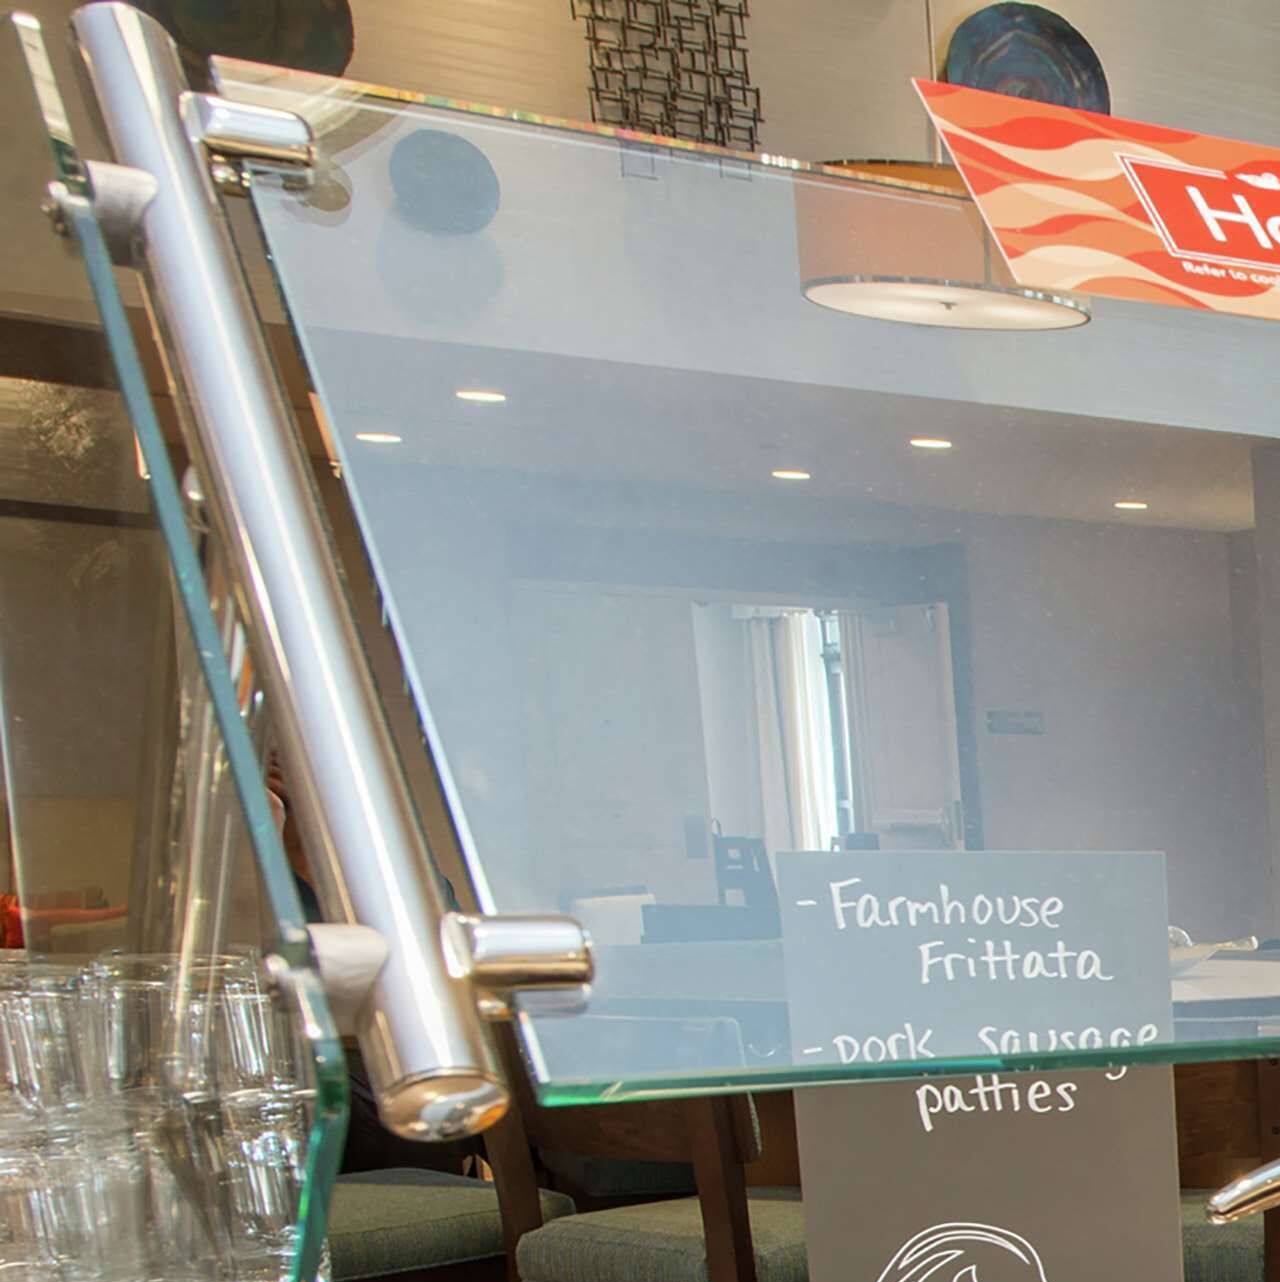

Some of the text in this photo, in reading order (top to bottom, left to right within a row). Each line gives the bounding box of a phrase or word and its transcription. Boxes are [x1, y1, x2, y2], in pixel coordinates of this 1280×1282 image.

[1181, 260, 1227, 278] Refer
[1229, 268, 1248, 281] to
[829, 878, 1064, 929] Farmhouse
[918, 938, 1115, 984] Frittata
[915, 1073, 1077, 1132] patties
